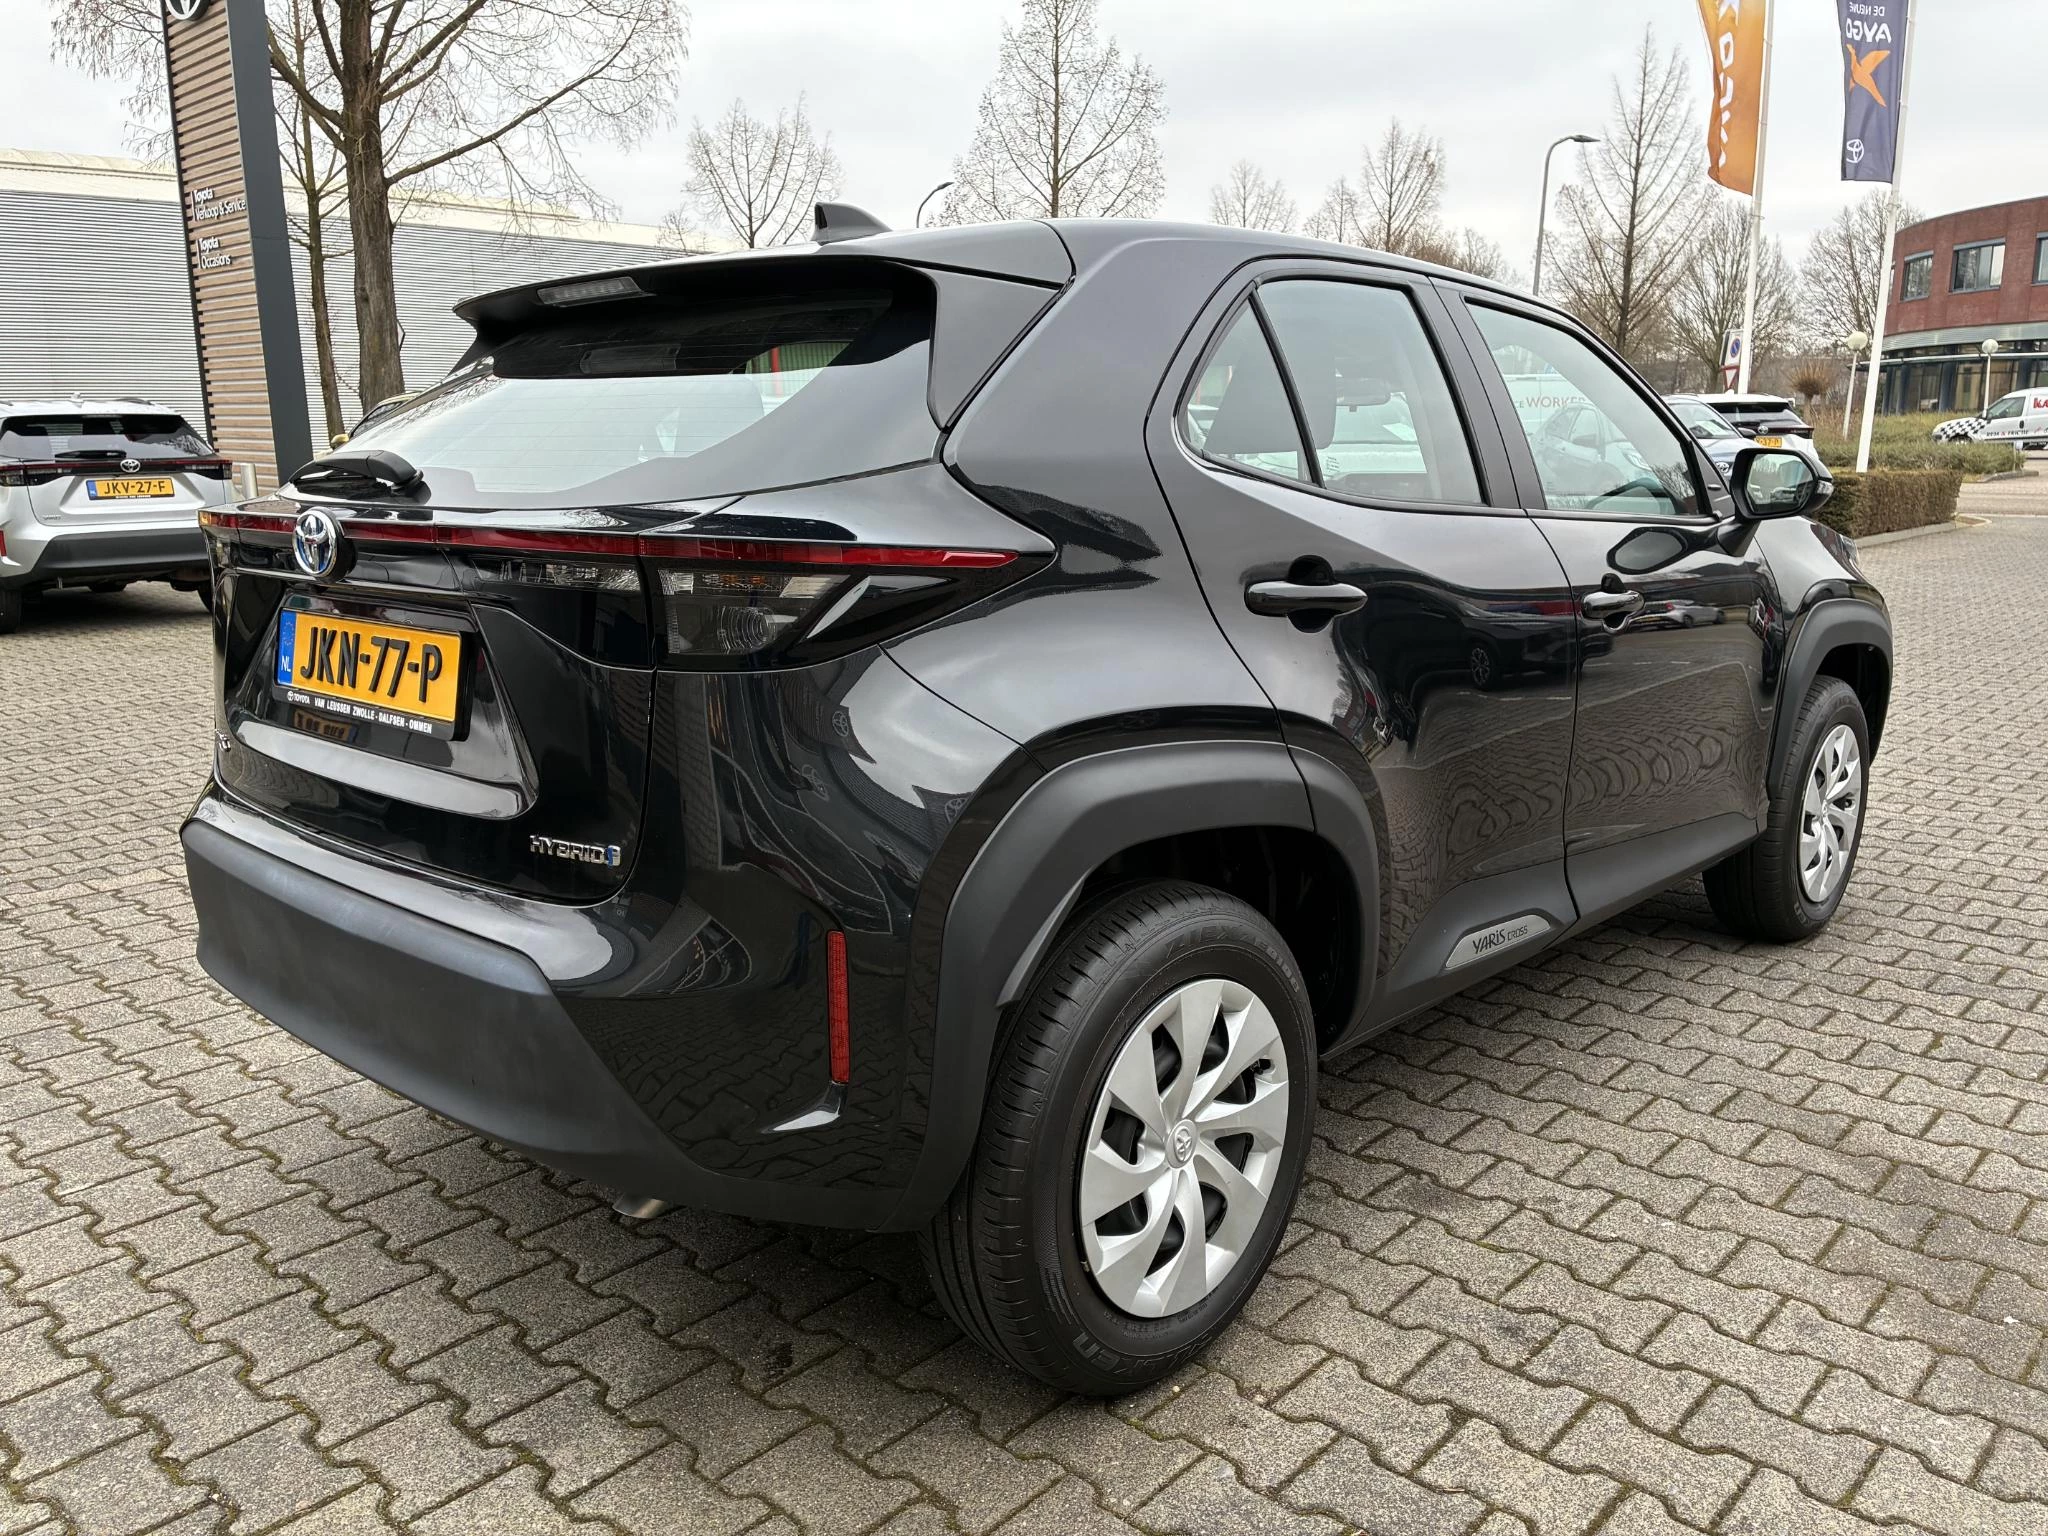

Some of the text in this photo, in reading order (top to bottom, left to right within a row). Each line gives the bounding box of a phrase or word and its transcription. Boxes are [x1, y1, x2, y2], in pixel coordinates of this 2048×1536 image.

[193, 187, 214, 206] Toyota
[195, 205, 219, 220] Verkoop
[225, 198, 246, 214] Service
[199, 236, 219, 254] Toyota
[201, 253, 231, 269] Occasions
[104, 480, 166, 495] JKV-27-F
[281, 655, 292, 673] NL
[300, 626, 443, 704] JKN-77-P
[293, 693, 311, 705] TOYOTA
[314, 697, 325, 709] VAN
[326, 700, 351, 715] LEUSSEN
[352, 706, 375, 720] ZWOLLE
[378, 712, 405, 728] DALFSEN
[408, 719, 432, 735] OMMEN
[529, 835, 605, 865] HYBRID
[1507, 925, 1529, 941] CROSS
